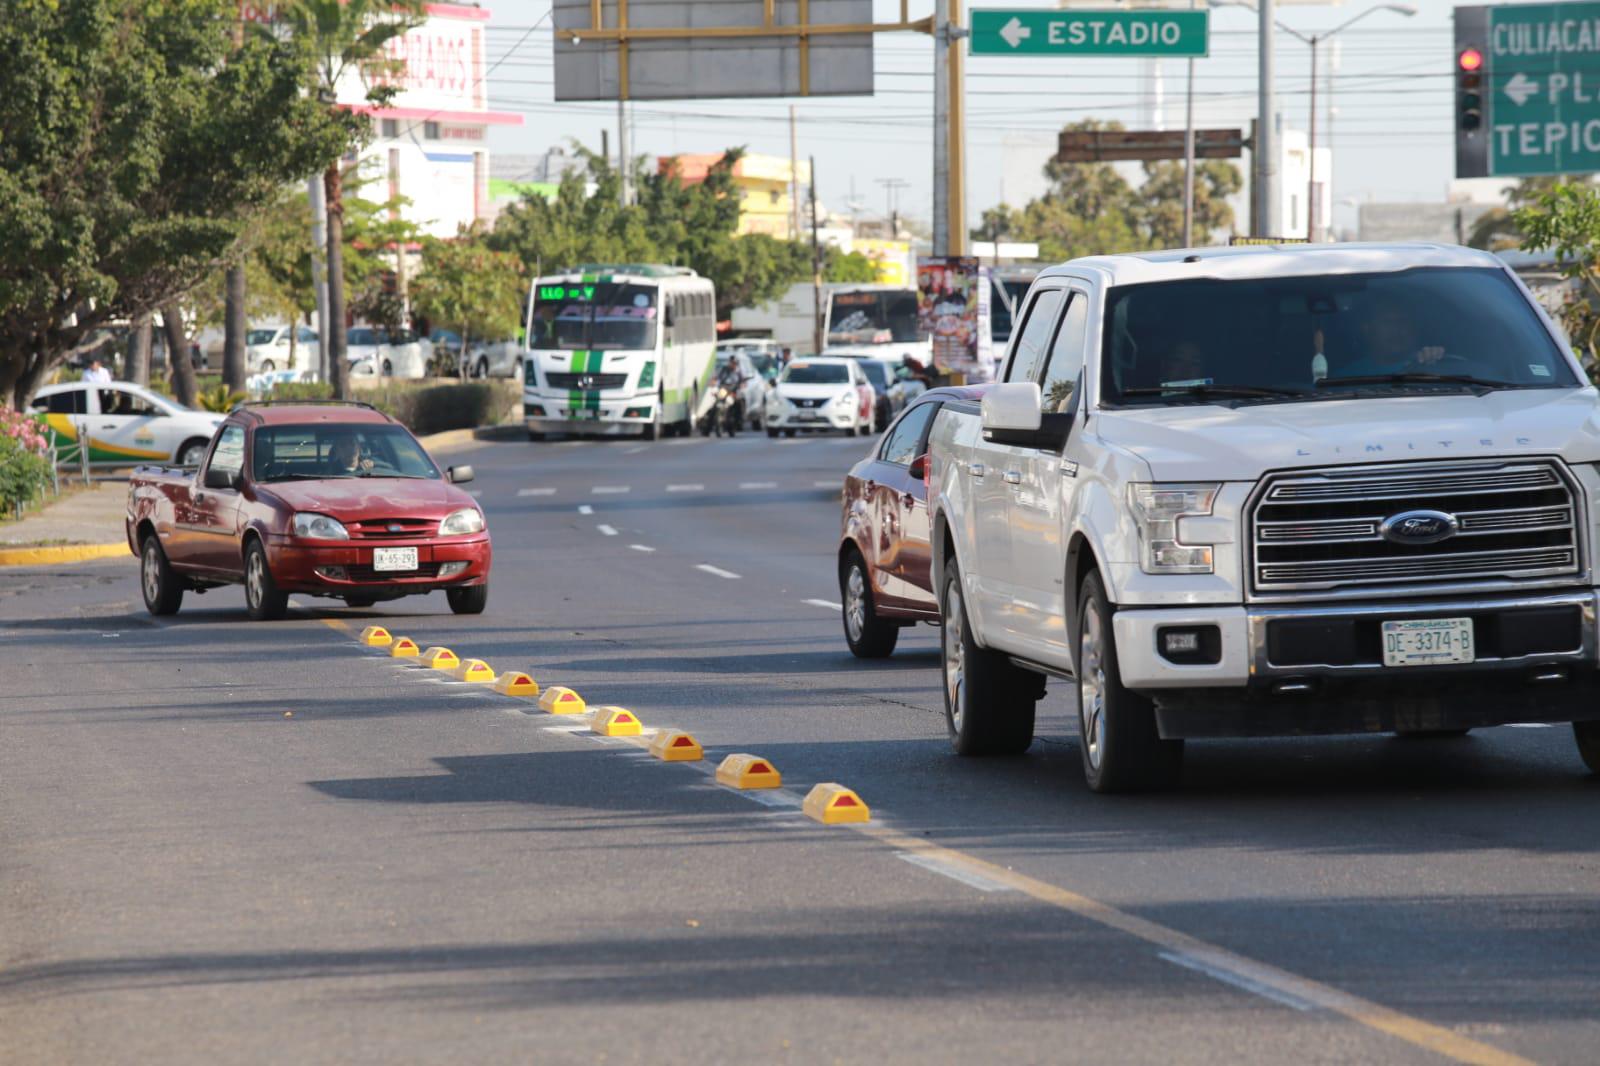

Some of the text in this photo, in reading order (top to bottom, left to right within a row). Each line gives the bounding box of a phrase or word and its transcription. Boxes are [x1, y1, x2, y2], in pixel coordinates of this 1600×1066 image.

[1047, 21, 1181, 45] ESTADIO
[1548, 72, 1600, 104] PL
[1495, 119, 1600, 156] TEPIC
[1402, 518, 1441, 536] Ford
[1386, 630, 1470, 653] DE-3374-B
